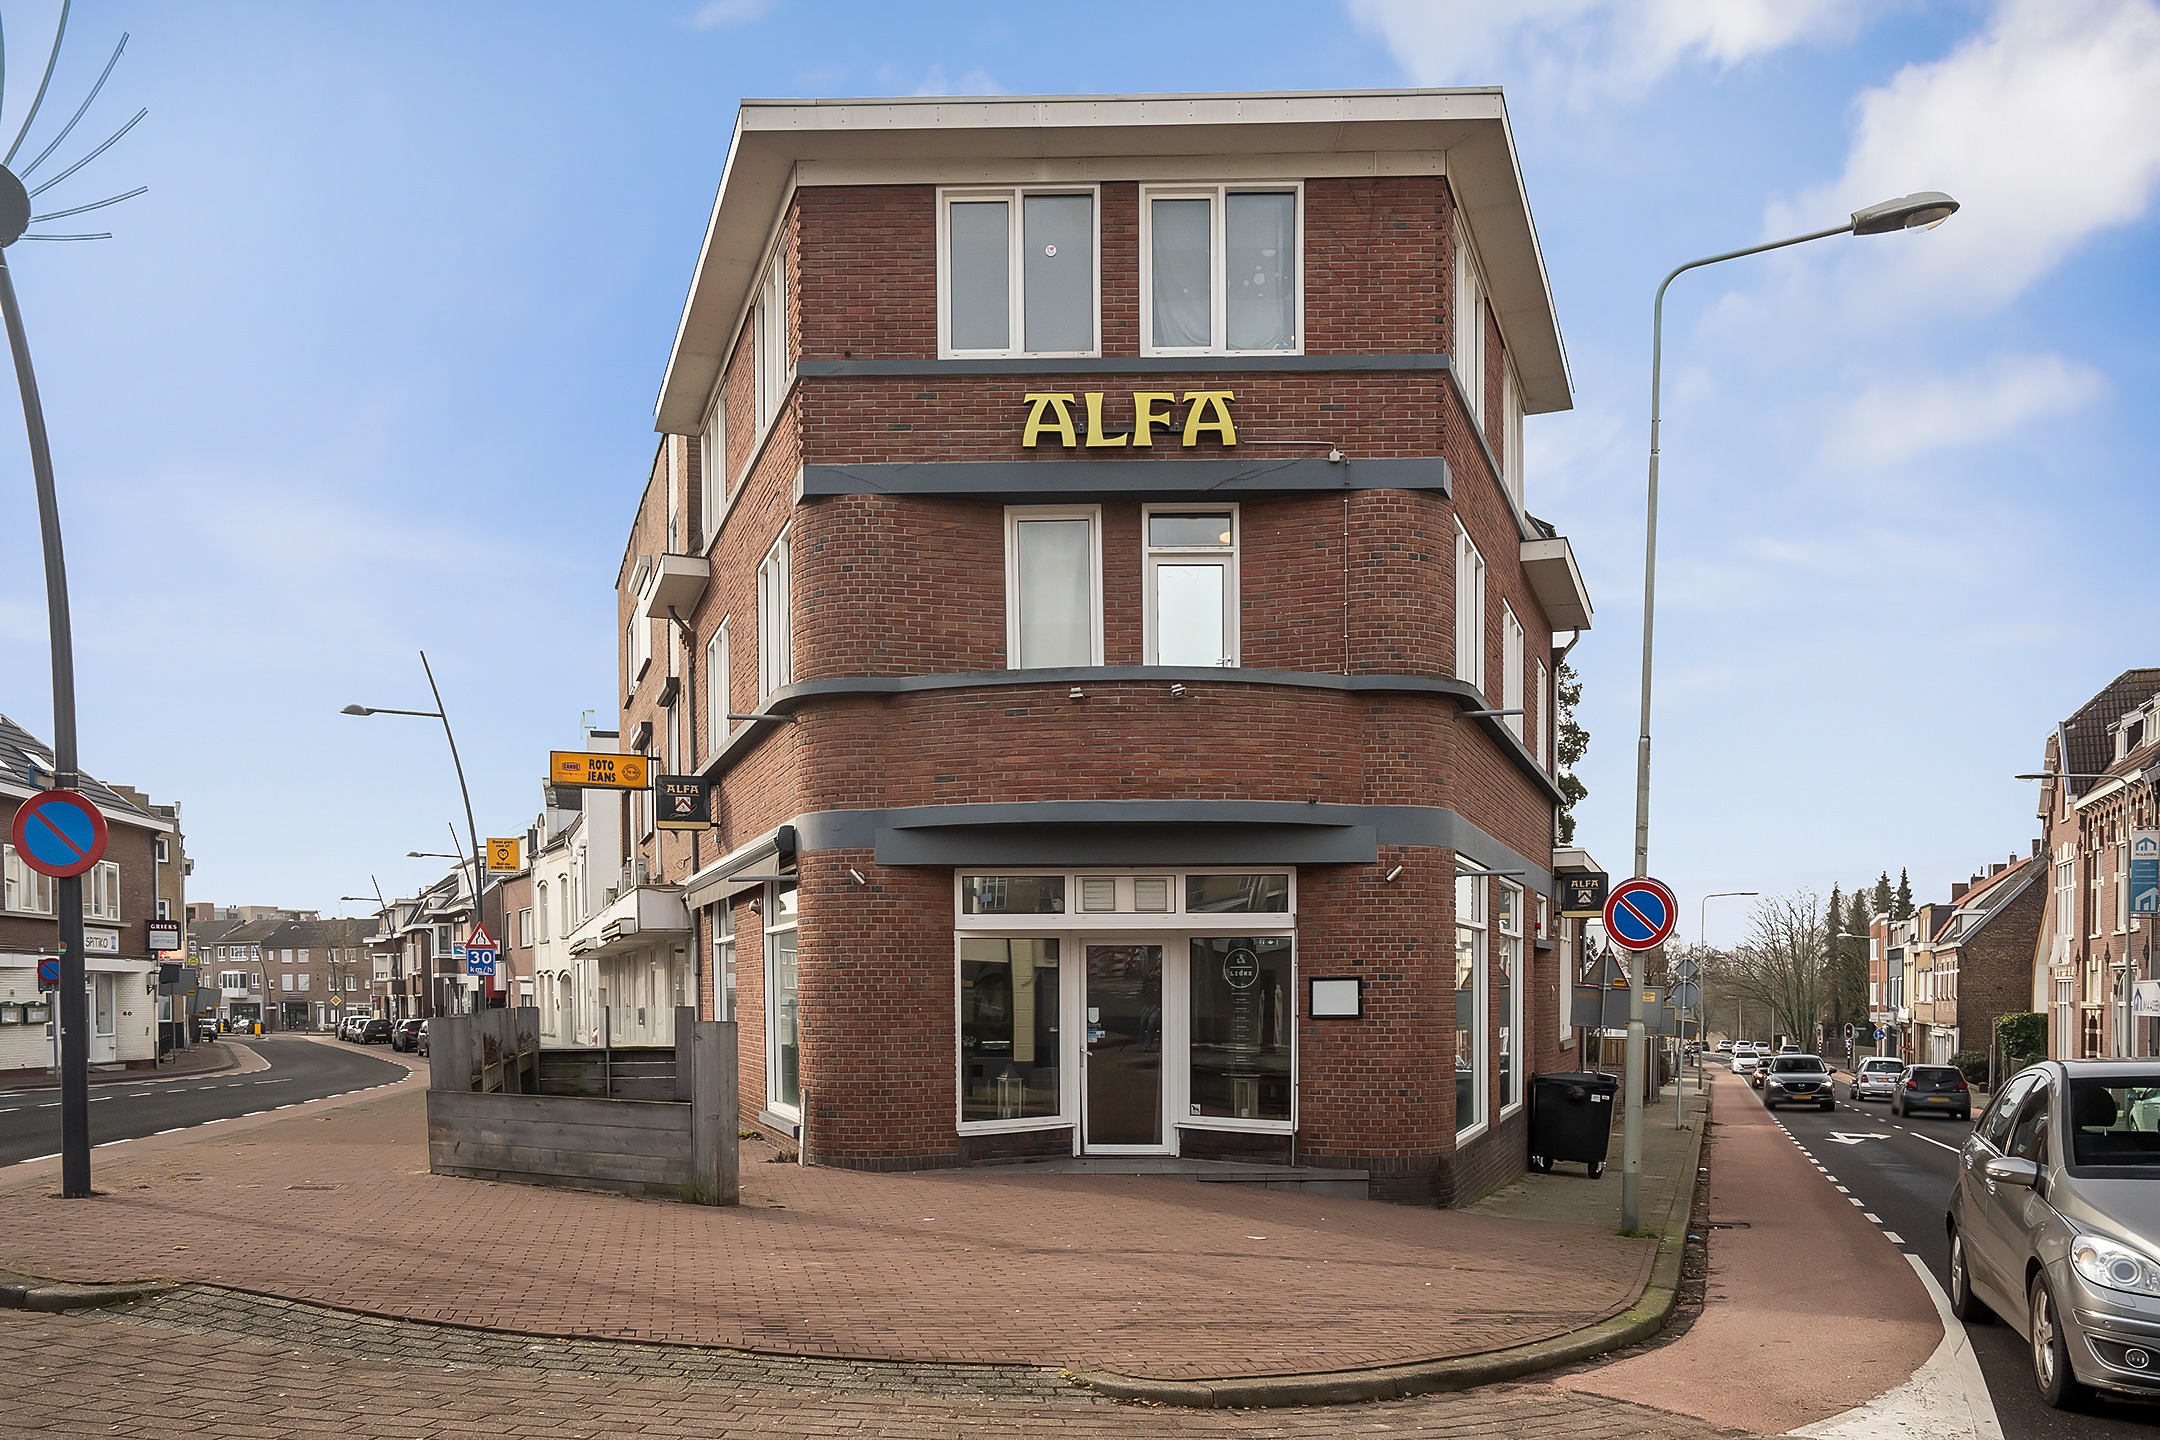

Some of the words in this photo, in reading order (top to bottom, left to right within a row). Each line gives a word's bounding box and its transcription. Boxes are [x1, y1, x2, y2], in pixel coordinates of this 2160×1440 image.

[1022, 390, 1237, 447] ALFA
[588, 759, 614, 771] ROTO
[587, 771, 616, 782] JEANS
[667, 784, 699, 794] ALFA
[470, 951, 492, 964] 30
